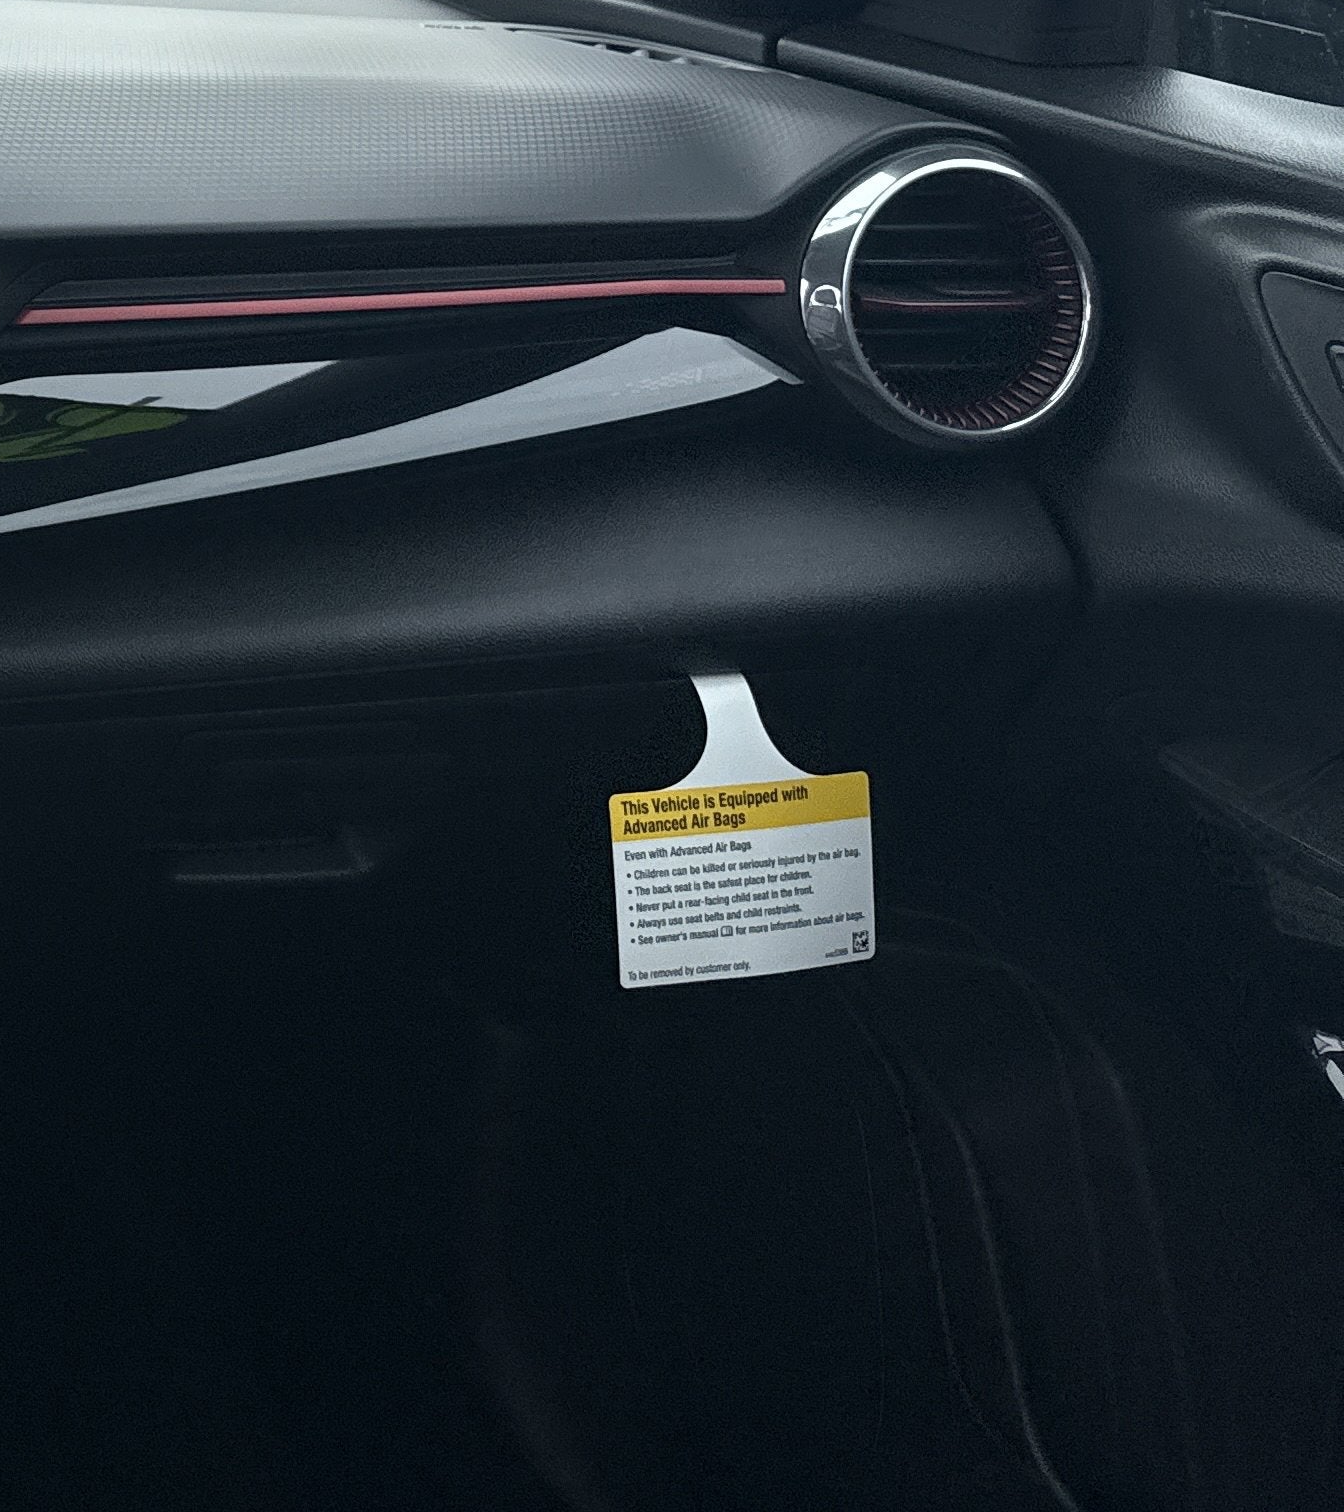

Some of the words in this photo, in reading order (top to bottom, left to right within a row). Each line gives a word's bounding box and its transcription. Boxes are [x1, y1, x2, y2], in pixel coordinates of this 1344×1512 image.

[621, 800, 649, 816] This
[651, 795, 700, 814] Vehicle
[703, 793, 716, 808] is
[719, 788, 779, 810] Equipped
[782, 785, 809, 802] with
[623, 815, 688, 835] Advanced
[691, 813, 711, 828] Air
[713, 811, 746, 828] Bags
[624, 850, 647, 861] Even
[649, 848, 668, 859] with
[670, 843, 713, 857] Advanced
[714, 842, 728, 853] Air
[730, 840, 752, 852] Bags
[634, 869, 670, 880] Children
[672, 867, 688, 876] can
[689, 865, 700, 875] be
[703, 862, 725, 873] killed
[727, 862, 737, 871] or
[739, 857, 775, 870] seriously
[777, 854, 805, 867] injured
[807, 852, 817, 864] by
[818, 851, 830, 861] the
[832, 848, 842, 859] air
[844, 848, 861, 858] bag.
[635, 886, 651, 896] The
[652, 884, 672, 894] back
[674, 881, 692, 892] seat
[694, 881, 701, 891] is
[703, 880, 716, 890] the
[718, 877, 743, 888] safest
[744, 875, 765, 887] place
[767, 873, 778, 883] for
[779, 870, 812, 882] children.
[636, 902, 660, 912] Never
[662, 900, 676, 912] put
[678, 901, 683, 909] a
[685, 895, 730, 907] rear-facing
[731, 892, 751, 904] child
[752, 891, 769, 901] seat
[771, 890, 779, 899] in
[780, 888, 793, 898] the
[637, 918, 667, 929] Always
[668, 916, 683, 926] use
[685, 914, 703, 924] seat
[704, 911, 725, 922] belts
[726, 909, 742, 920] and
[743, 907, 763, 919] child
[638, 935, 653, 945] See
[655, 931, 688, 943] owner's
[689, 928, 719, 940] manual
[736, 925, 747, 935] for
[748, 924, 768, 933] more
[770, 918, 812, 931] information
[813, 914, 833, 926] about
[835, 913, 845, 923] air
[628, 971, 637, 981] To
[638, 970, 648, 980] be
[650, 966, 683, 979] removed
[685, 966, 694, 976] by
[696, 963, 732, 974] customer
[733, 960, 751, 972] only.
